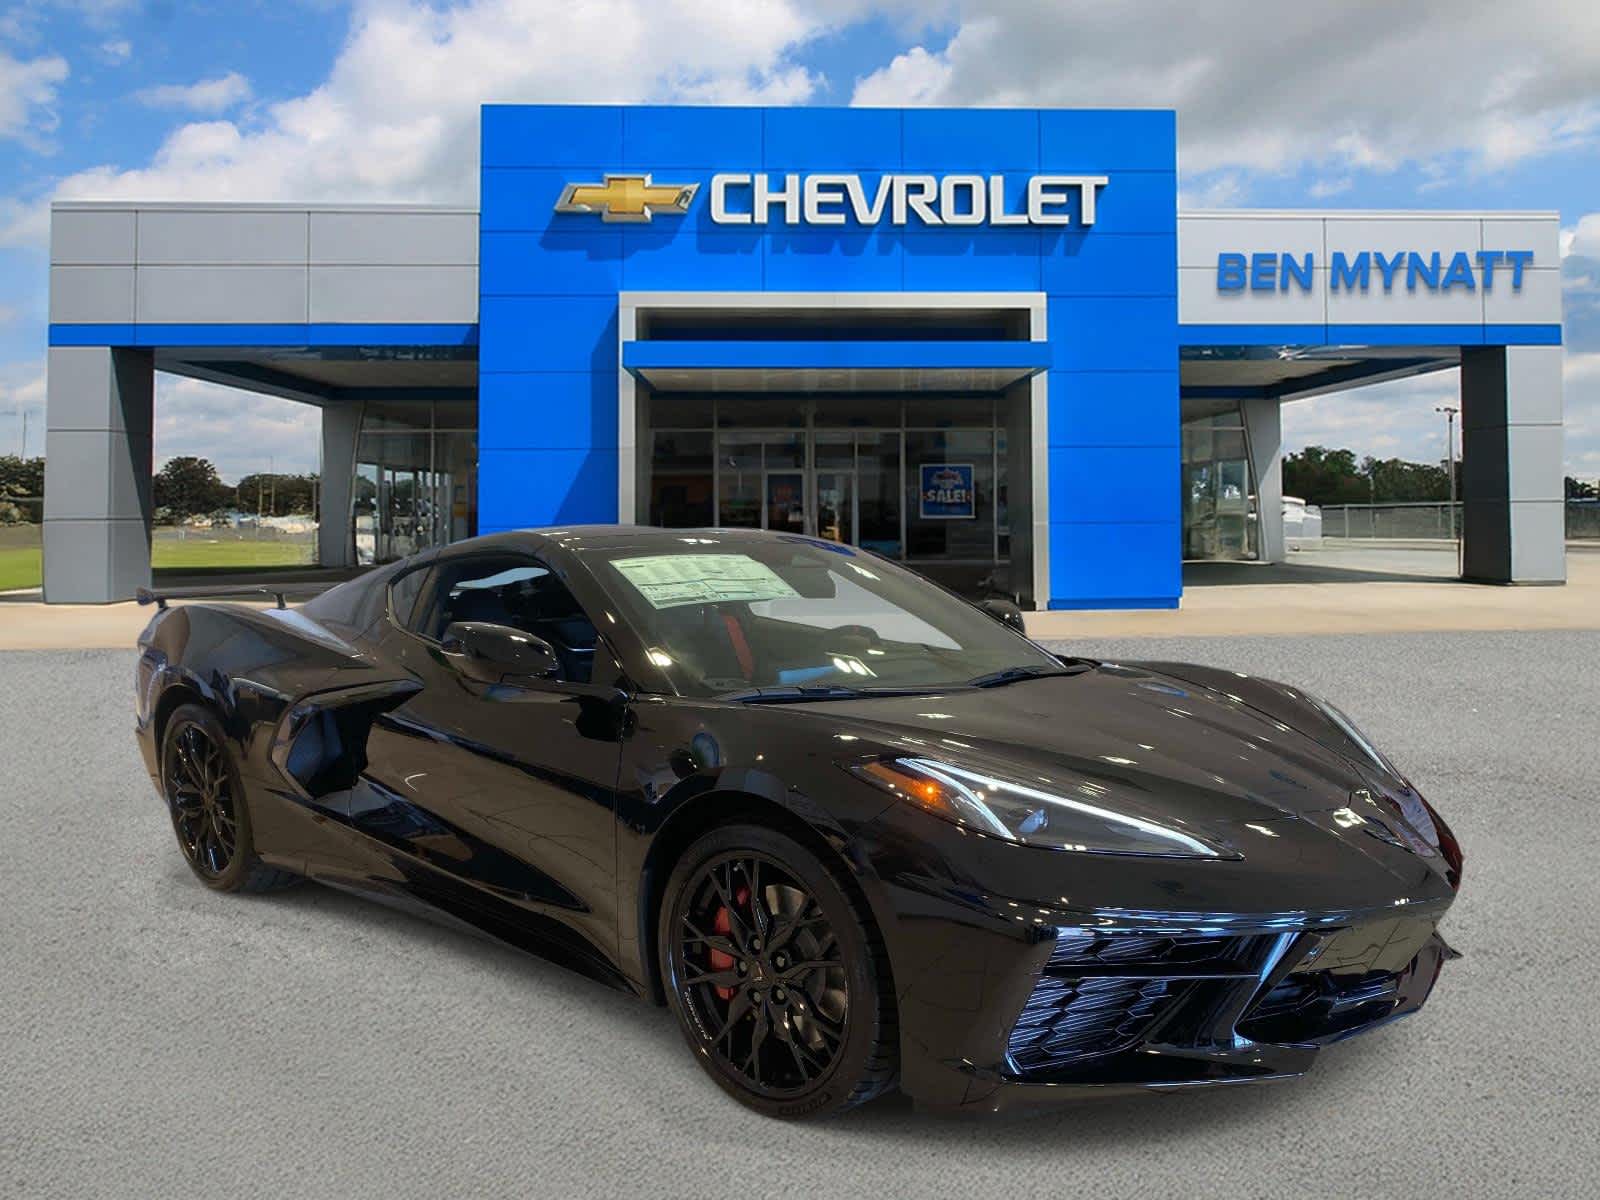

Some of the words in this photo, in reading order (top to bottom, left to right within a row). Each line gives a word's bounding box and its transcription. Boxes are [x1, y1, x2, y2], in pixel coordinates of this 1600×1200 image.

[710, 173, 1109, 225] CHEVROLET
[1217, 252, 1314, 291] BEN
[1330, 250, 1534, 291] MYNATT
